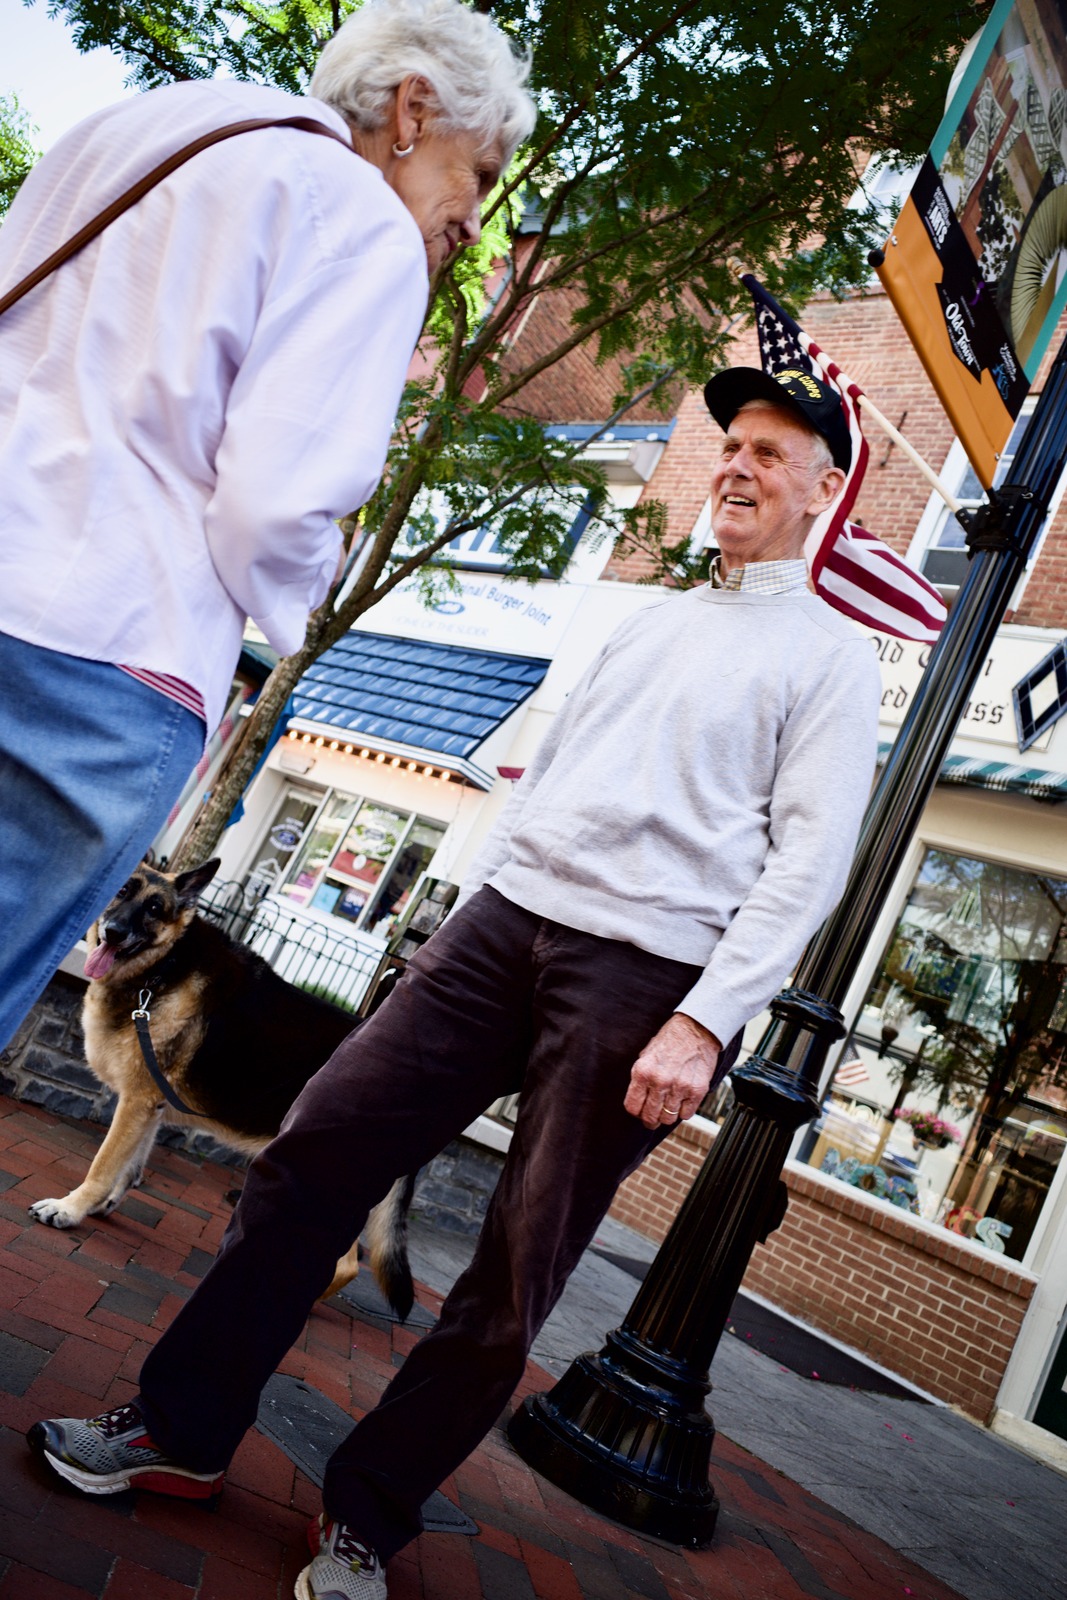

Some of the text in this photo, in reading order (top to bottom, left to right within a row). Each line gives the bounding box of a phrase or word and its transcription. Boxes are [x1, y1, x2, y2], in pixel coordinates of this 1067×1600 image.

[929, 205, 948, 243] ARTS
[946, 303, 964, 333] Old
[957, 326, 975, 366] Town
[798, 375, 822, 399] CORPS
[486, 586, 524, 610] Burger
[521, 602, 551, 626] Joint
